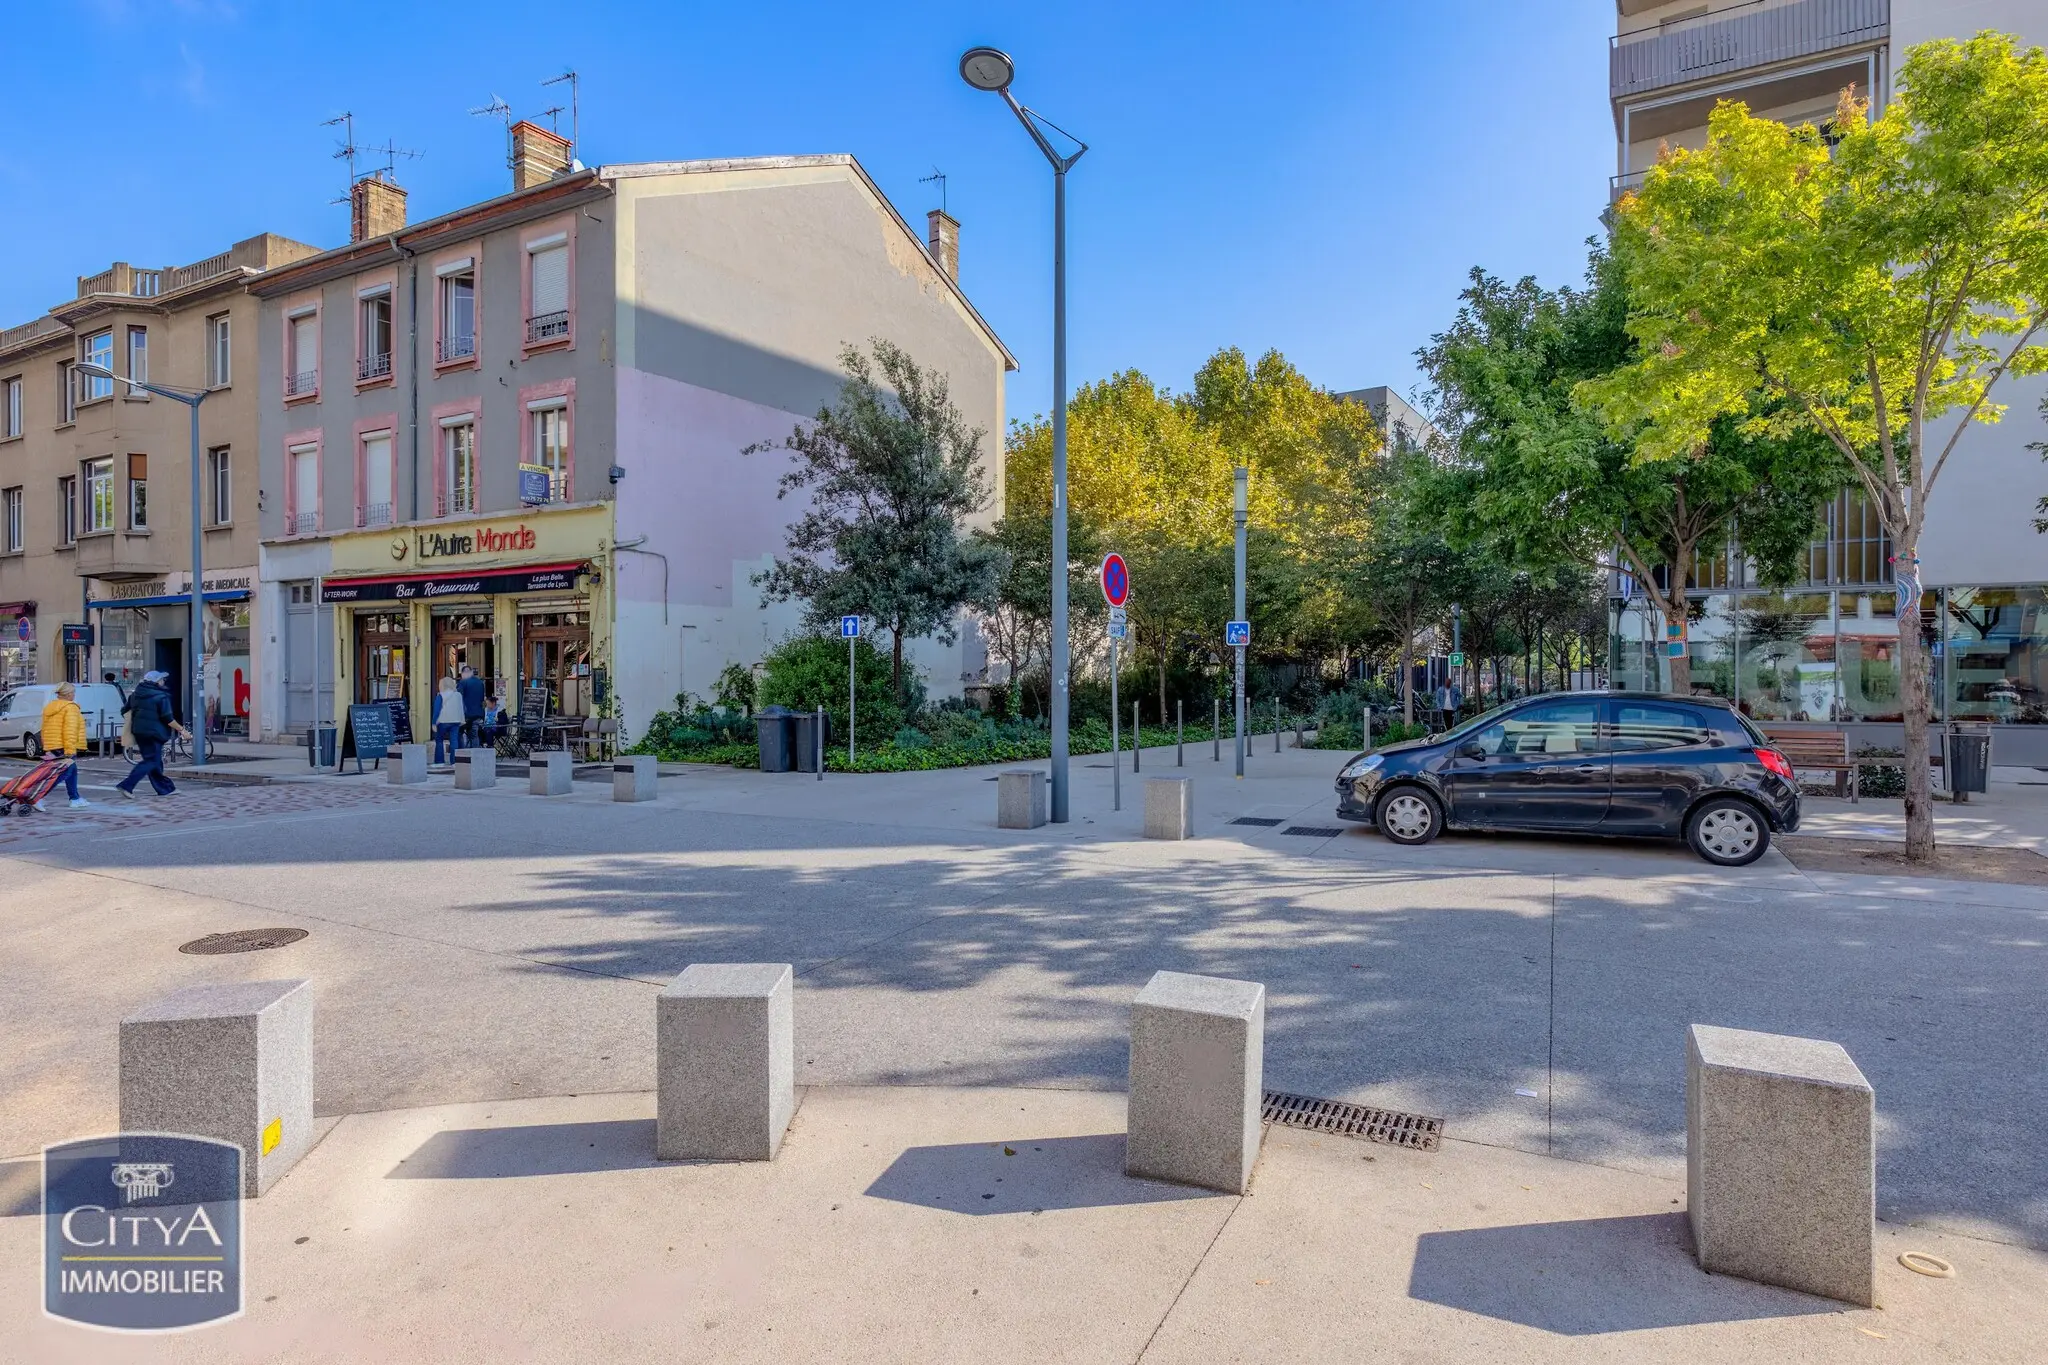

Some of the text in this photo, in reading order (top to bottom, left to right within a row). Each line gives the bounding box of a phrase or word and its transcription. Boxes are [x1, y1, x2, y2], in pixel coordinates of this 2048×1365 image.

[420, 524, 536, 558] L'Autre Monde
[110, 582, 166, 599] LABORATOIRE
[216, 578, 250, 590] MEDICALE
[396, 582, 480, 597] Bar Restaurant
[324, 590, 357, 598] AFTER-WORK
[1453, 656, 1459, 664] P
